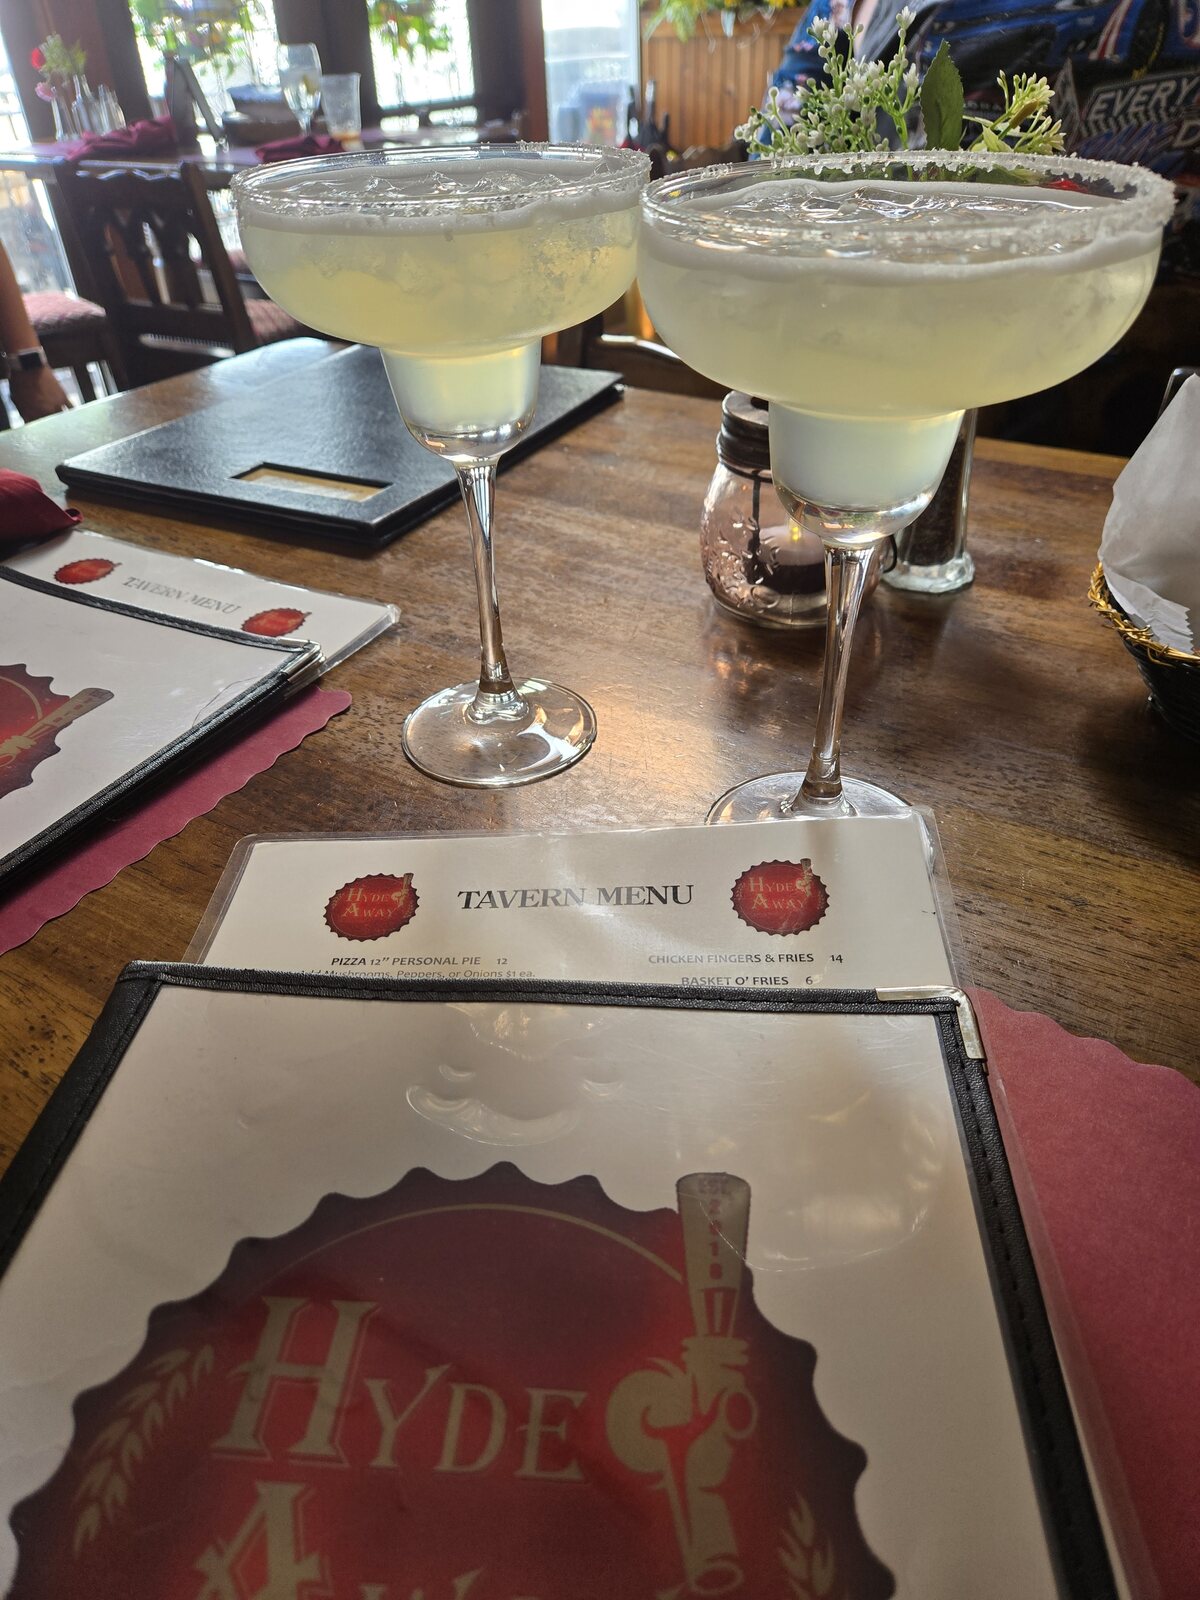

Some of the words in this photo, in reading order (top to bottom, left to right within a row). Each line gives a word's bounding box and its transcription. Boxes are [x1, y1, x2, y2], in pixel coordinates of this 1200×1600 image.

[1087, 76, 1200, 121] EVERY
[122, 576, 188, 600] TAVERN
[187, 594, 242, 614] MENU
[457, 887, 586, 910] TAVERN
[595, 884, 694, 906] MENU
[331, 957, 367, 966] PIZZA
[392, 956, 459, 966] PERSONAL
[461, 956, 481, 965] PIE
[648, 954, 704, 964] CHICKEN
[707, 953, 762, 963] FINGERS
[765, 953, 775, 963] &
[778, 953, 814, 962] FRIES
[831, 954, 844, 964] 14
[463, 969, 503, 978] Onions
[681, 976, 731, 985] BASKET
[753, 976, 789, 985] FRIES
[805, 976, 813, 985] 6
[209, 1296, 588, 1483] HYDE
